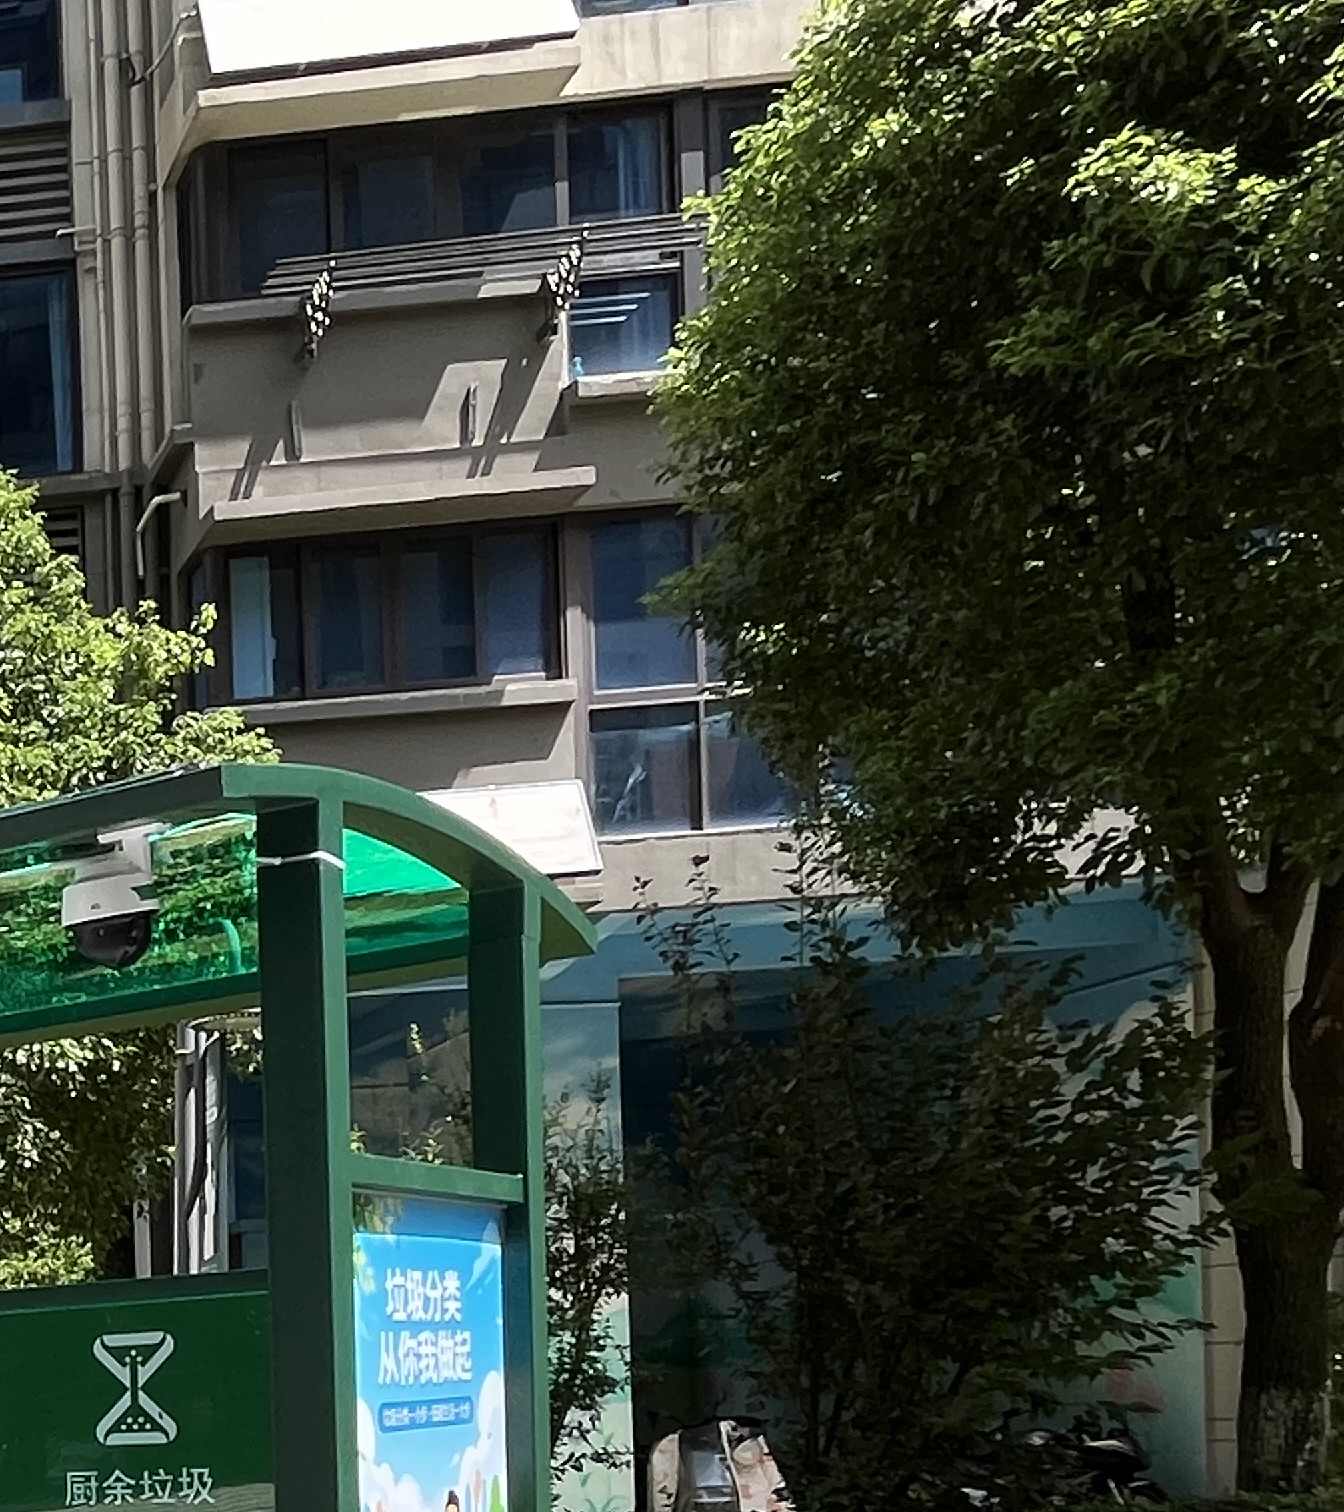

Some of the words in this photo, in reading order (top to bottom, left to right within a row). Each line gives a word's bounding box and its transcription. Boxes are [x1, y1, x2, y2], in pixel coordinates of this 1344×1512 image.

[385, 1267, 462, 1322] 垃圾分类
[377, 1330, 473, 1385] 从你我做起
[65, 1467, 215, 1506] 厨余垃圾
